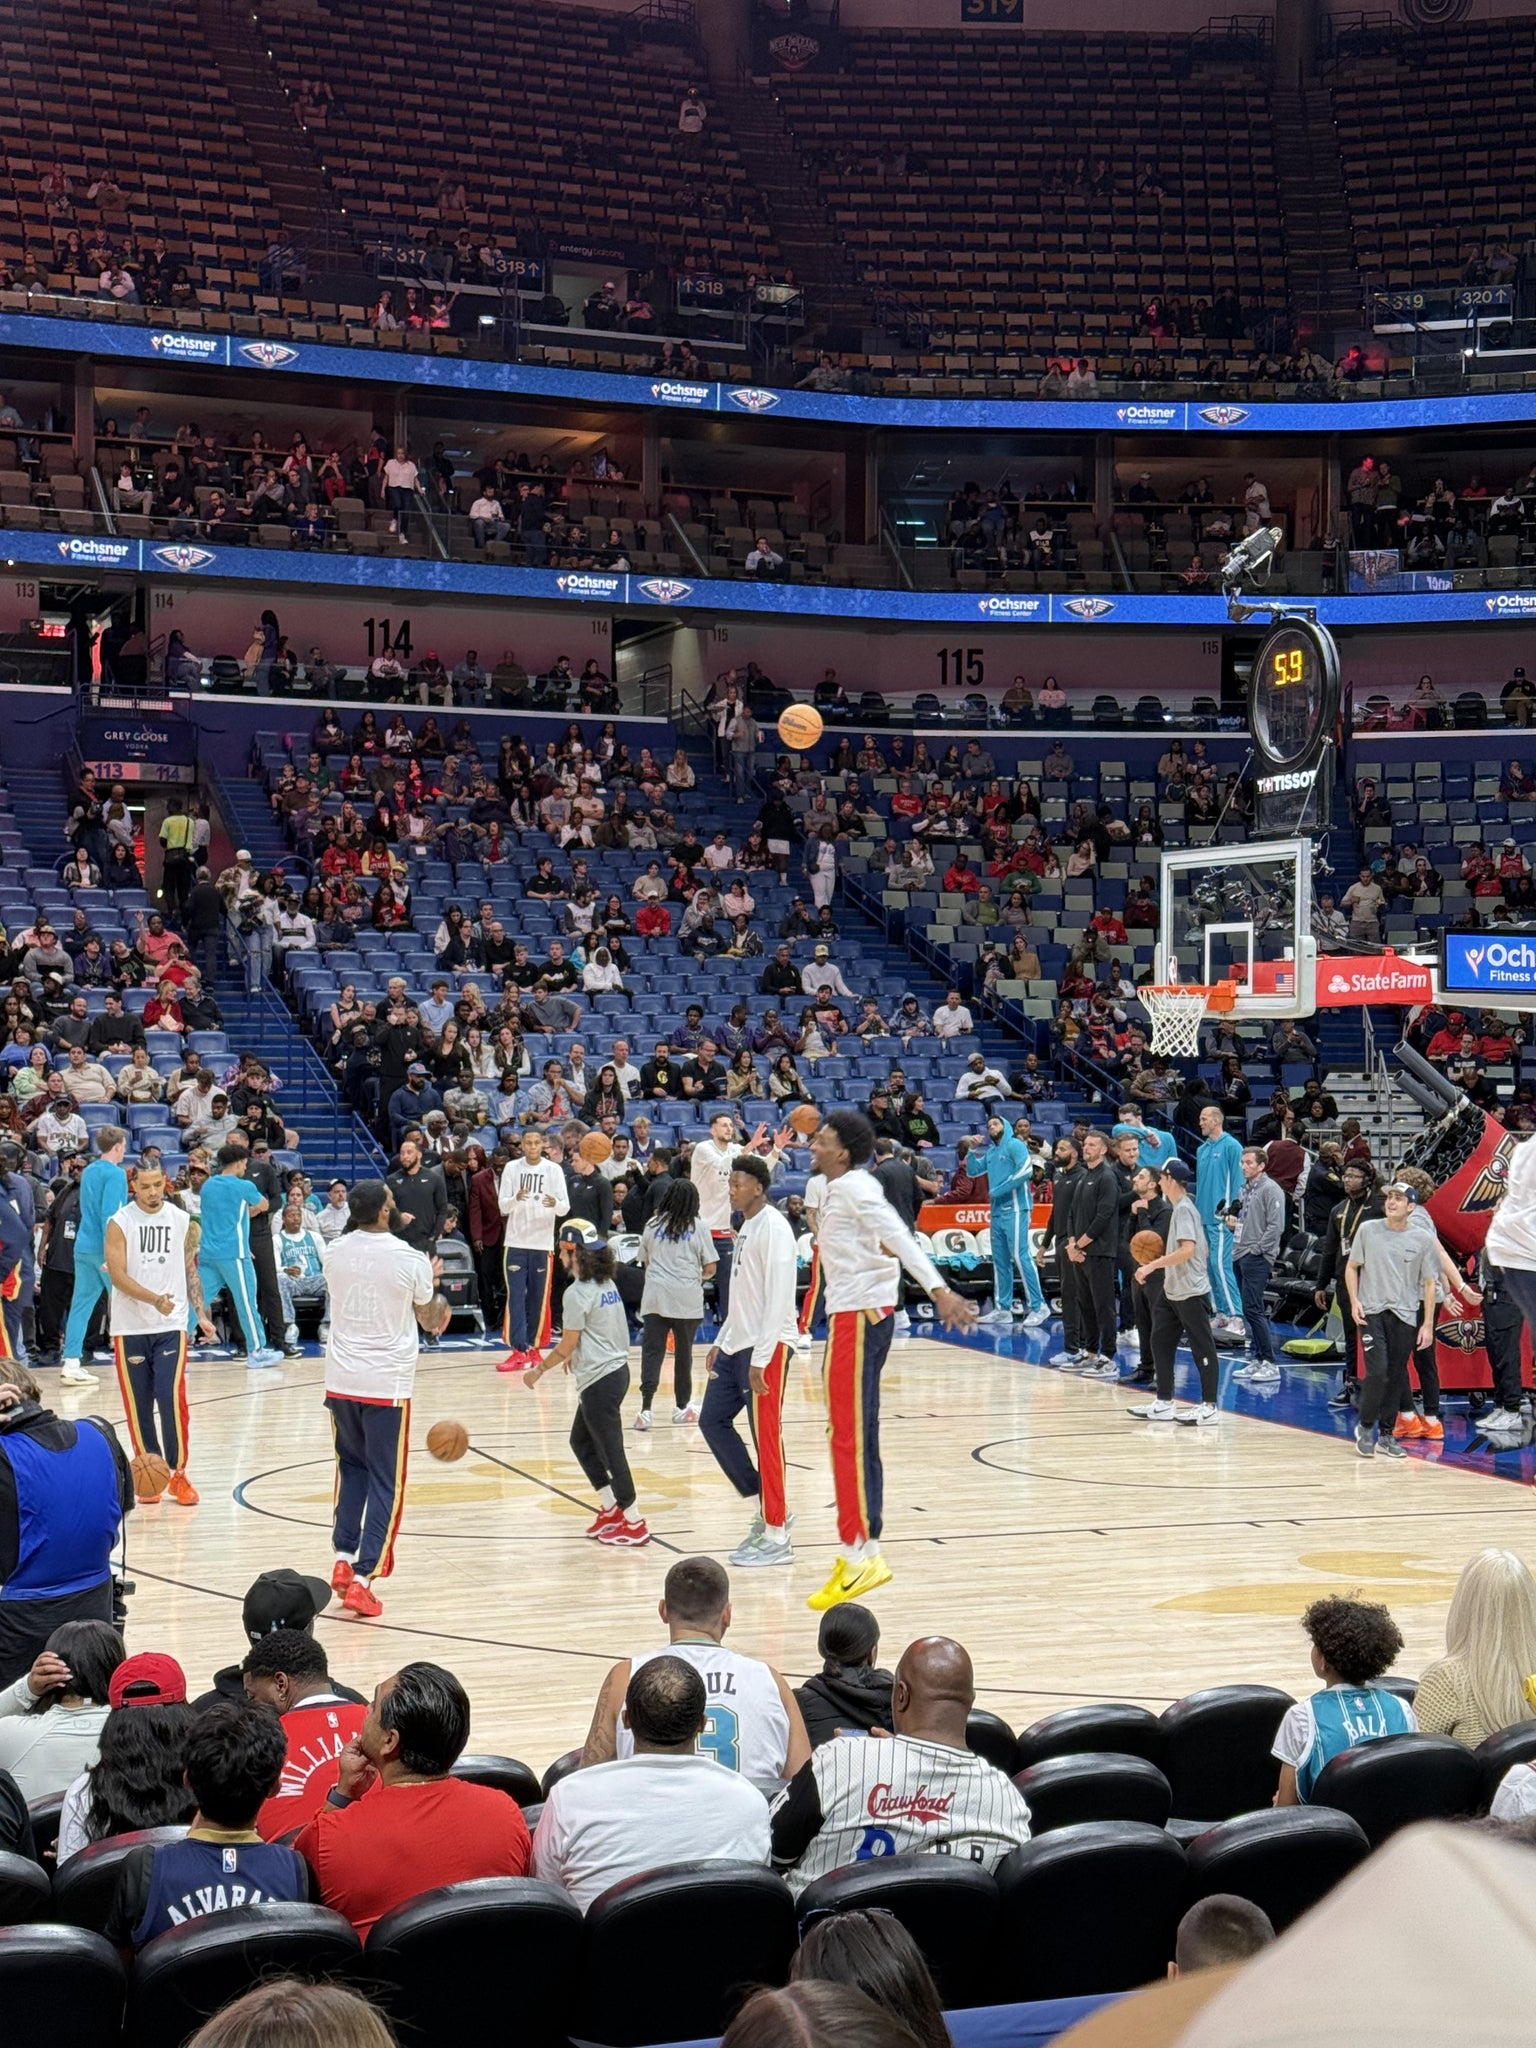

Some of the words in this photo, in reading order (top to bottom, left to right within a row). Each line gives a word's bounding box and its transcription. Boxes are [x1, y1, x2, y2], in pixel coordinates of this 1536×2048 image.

[560, 245, 593, 257] entergy
[496, 259, 526, 275] 318
[696, 280, 723, 295] 318
[757, 286, 785, 300] 319
[1462, 291, 1492, 305] 320
[163, 334, 217, 352] Ochsner
[661, 382, 709, 397] Ochsner
[1127, 406, 1176, 418] Ochsner
[70, 539, 129, 556] Ochsner
[16, 582, 35, 598] 113
[567, 575, 618, 590] Ochsner
[154, 593, 174, 609] 114
[989, 598, 1040, 611] Ochsner
[592, 621, 608, 635] 114
[713, 628, 729, 642] 115
[363, 617, 414, 659] 114
[1202, 641, 1218, 654] 115
[937, 648, 984, 686] 115
[104, 731, 131, 741] GREY
[133, 732, 168, 742] GOOSE
[95, 763, 123, 778] 113
[156, 765, 180, 782] 114
[1273, 770, 1317, 792] TISSOT
[1490, 970, 1531, 982] Fitness
[520, 1173, 544, 1194] VOTE
[139, 1225, 171, 1253] VOTE
[706, 1672, 736, 1695] UL
[276, 1731, 361, 1799] WILLIA
[867, 1783, 957, 1825] Crawford
[167, 1885, 278, 1926] ALVARA
